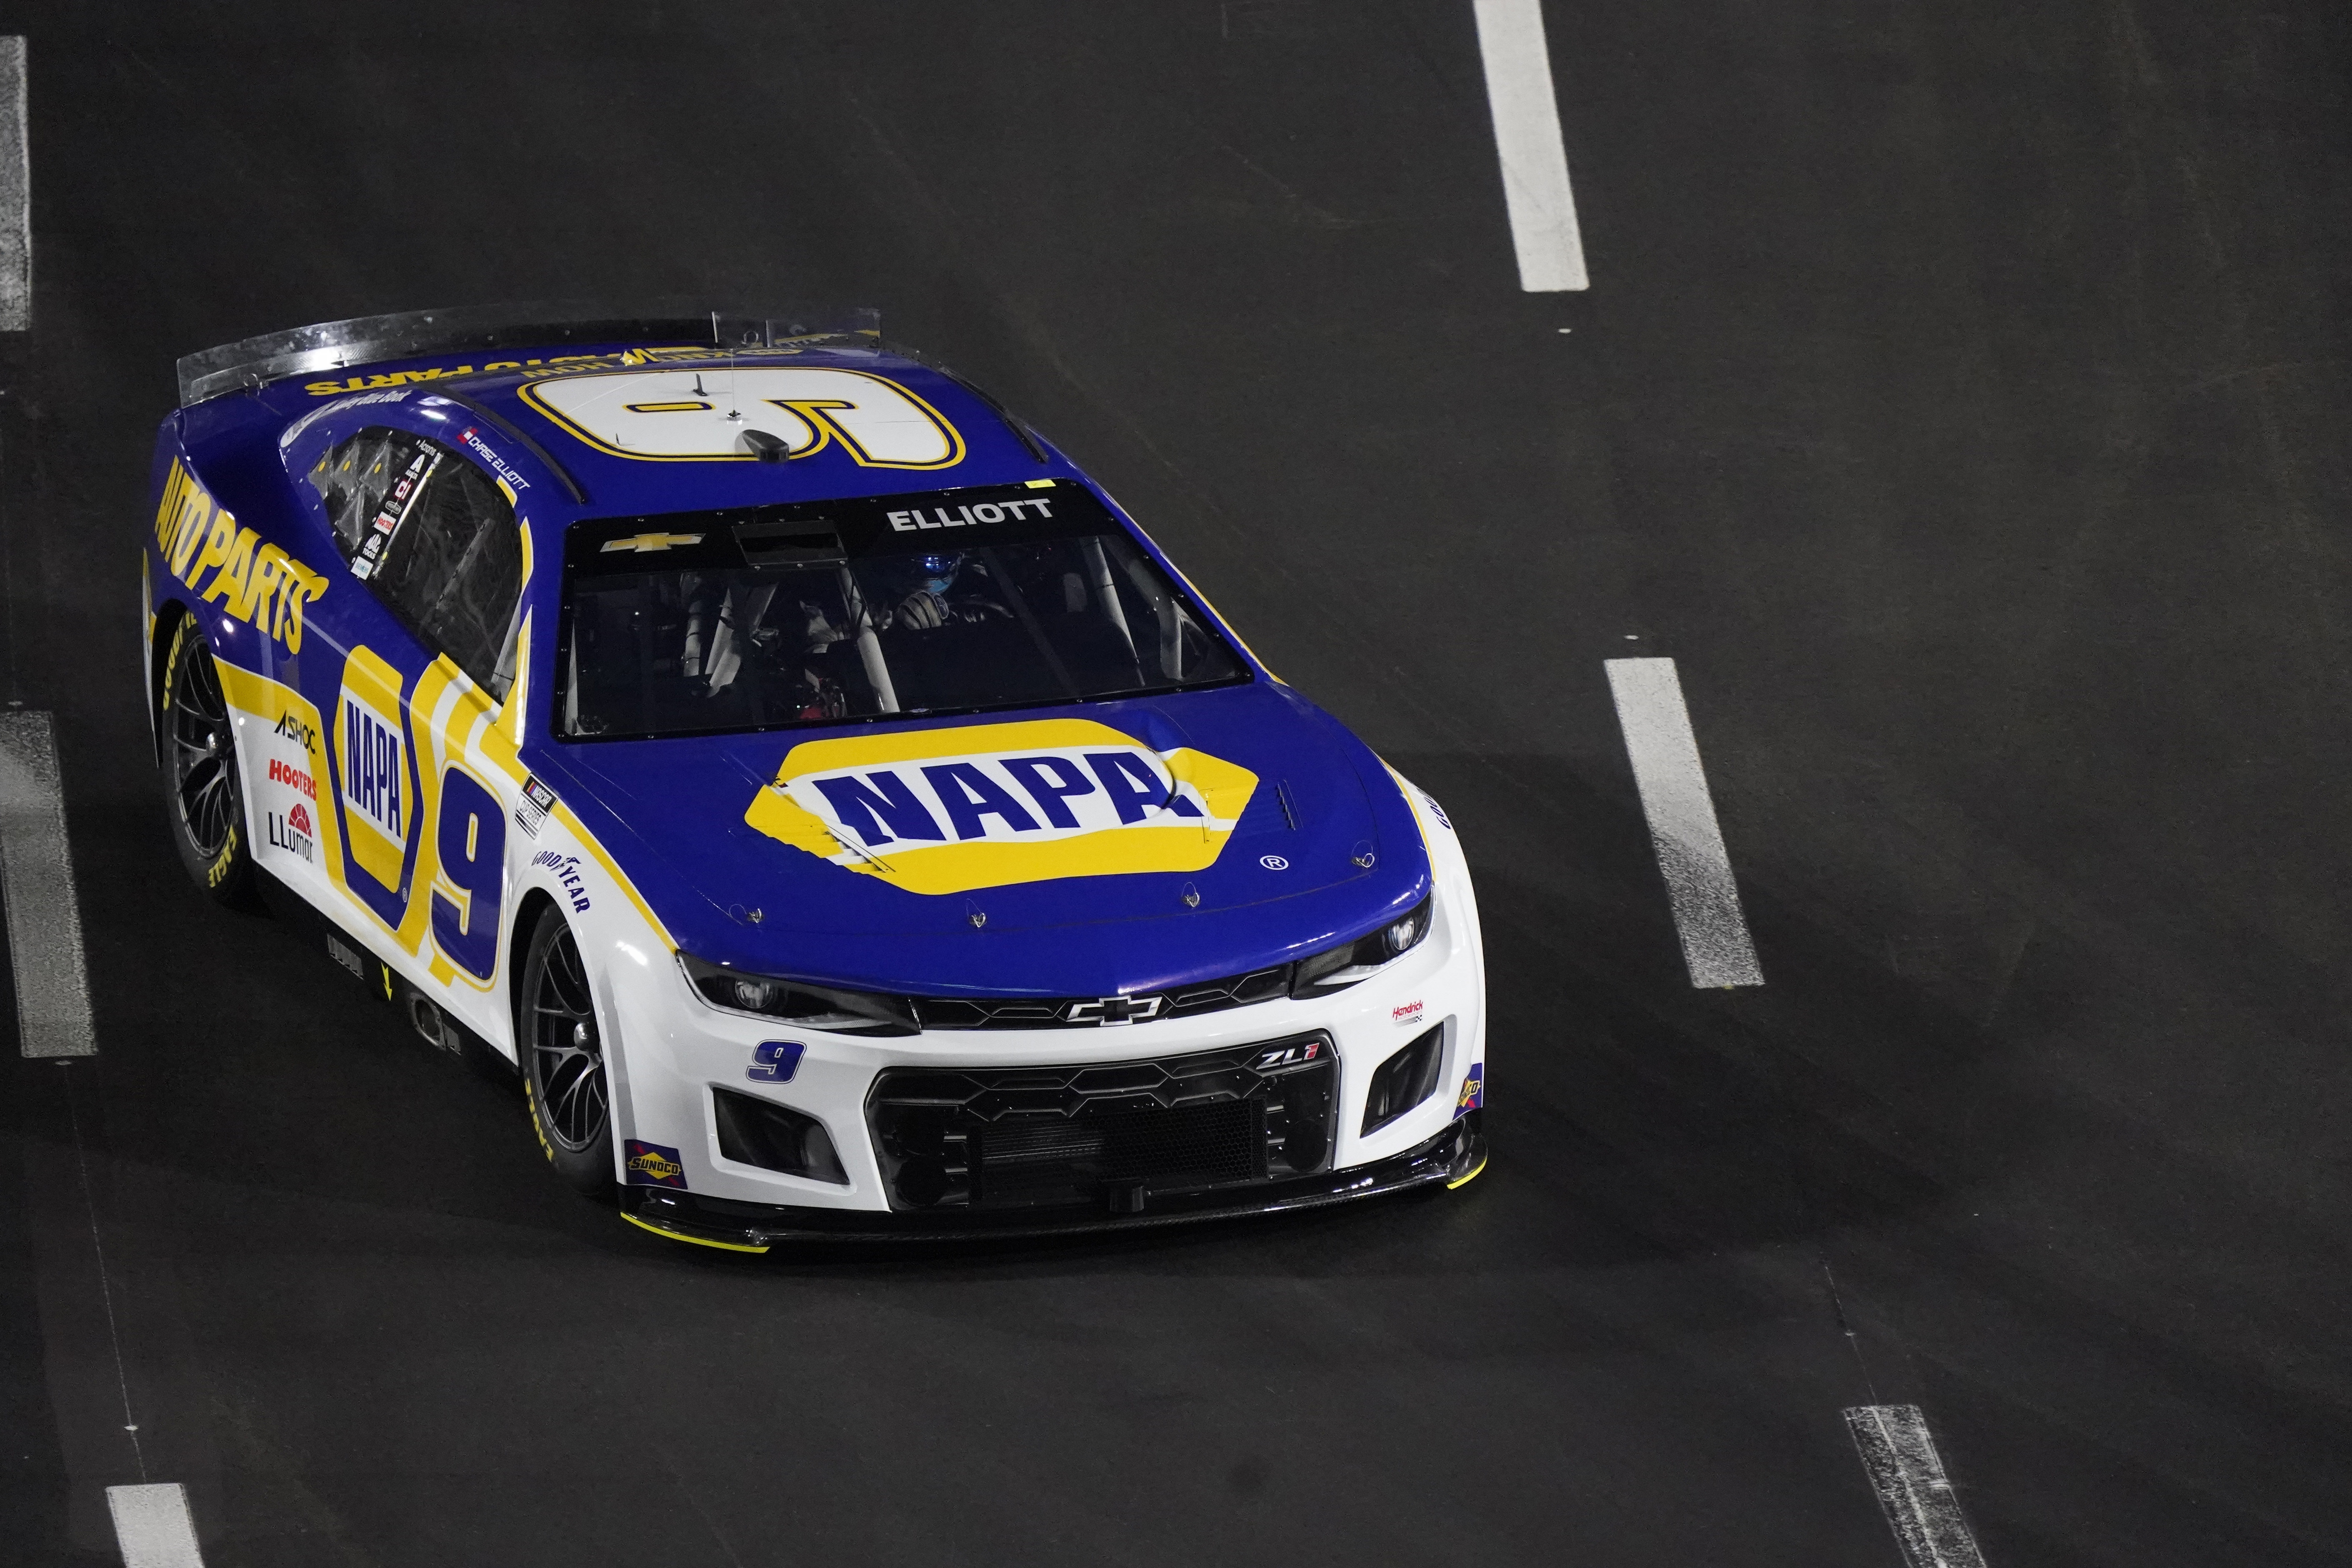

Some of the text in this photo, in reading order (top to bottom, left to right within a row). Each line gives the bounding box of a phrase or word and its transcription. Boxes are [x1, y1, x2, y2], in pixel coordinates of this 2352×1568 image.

[418, 439, 437, 457] Acronis
[468, 436, 531, 490] CHASE ELLIOTT
[886, 498, 1053, 532] ELLIOTT
[154, 455, 330, 655] AUTO PARTS
[362, 547, 377, 560] TOOLS
[269, 759, 317, 802] HOOTERS
[346, 699, 401, 839] NAPA
[520, 800, 541, 825] CUP SERIES
[531, 785, 553, 808] NASCAR
[812, 751, 1208, 848] NAPA
[269, 812, 313, 864] LLumar
[428, 759, 508, 993] 9
[532, 851, 591, 914] GOODYEAR
[1392, 1000, 1423, 1021] Hendrick
[746, 1039, 807, 1084] 9
[1255, 1042, 1320, 1070] ZL1
[630, 1158, 679, 1175] SUNOCO
